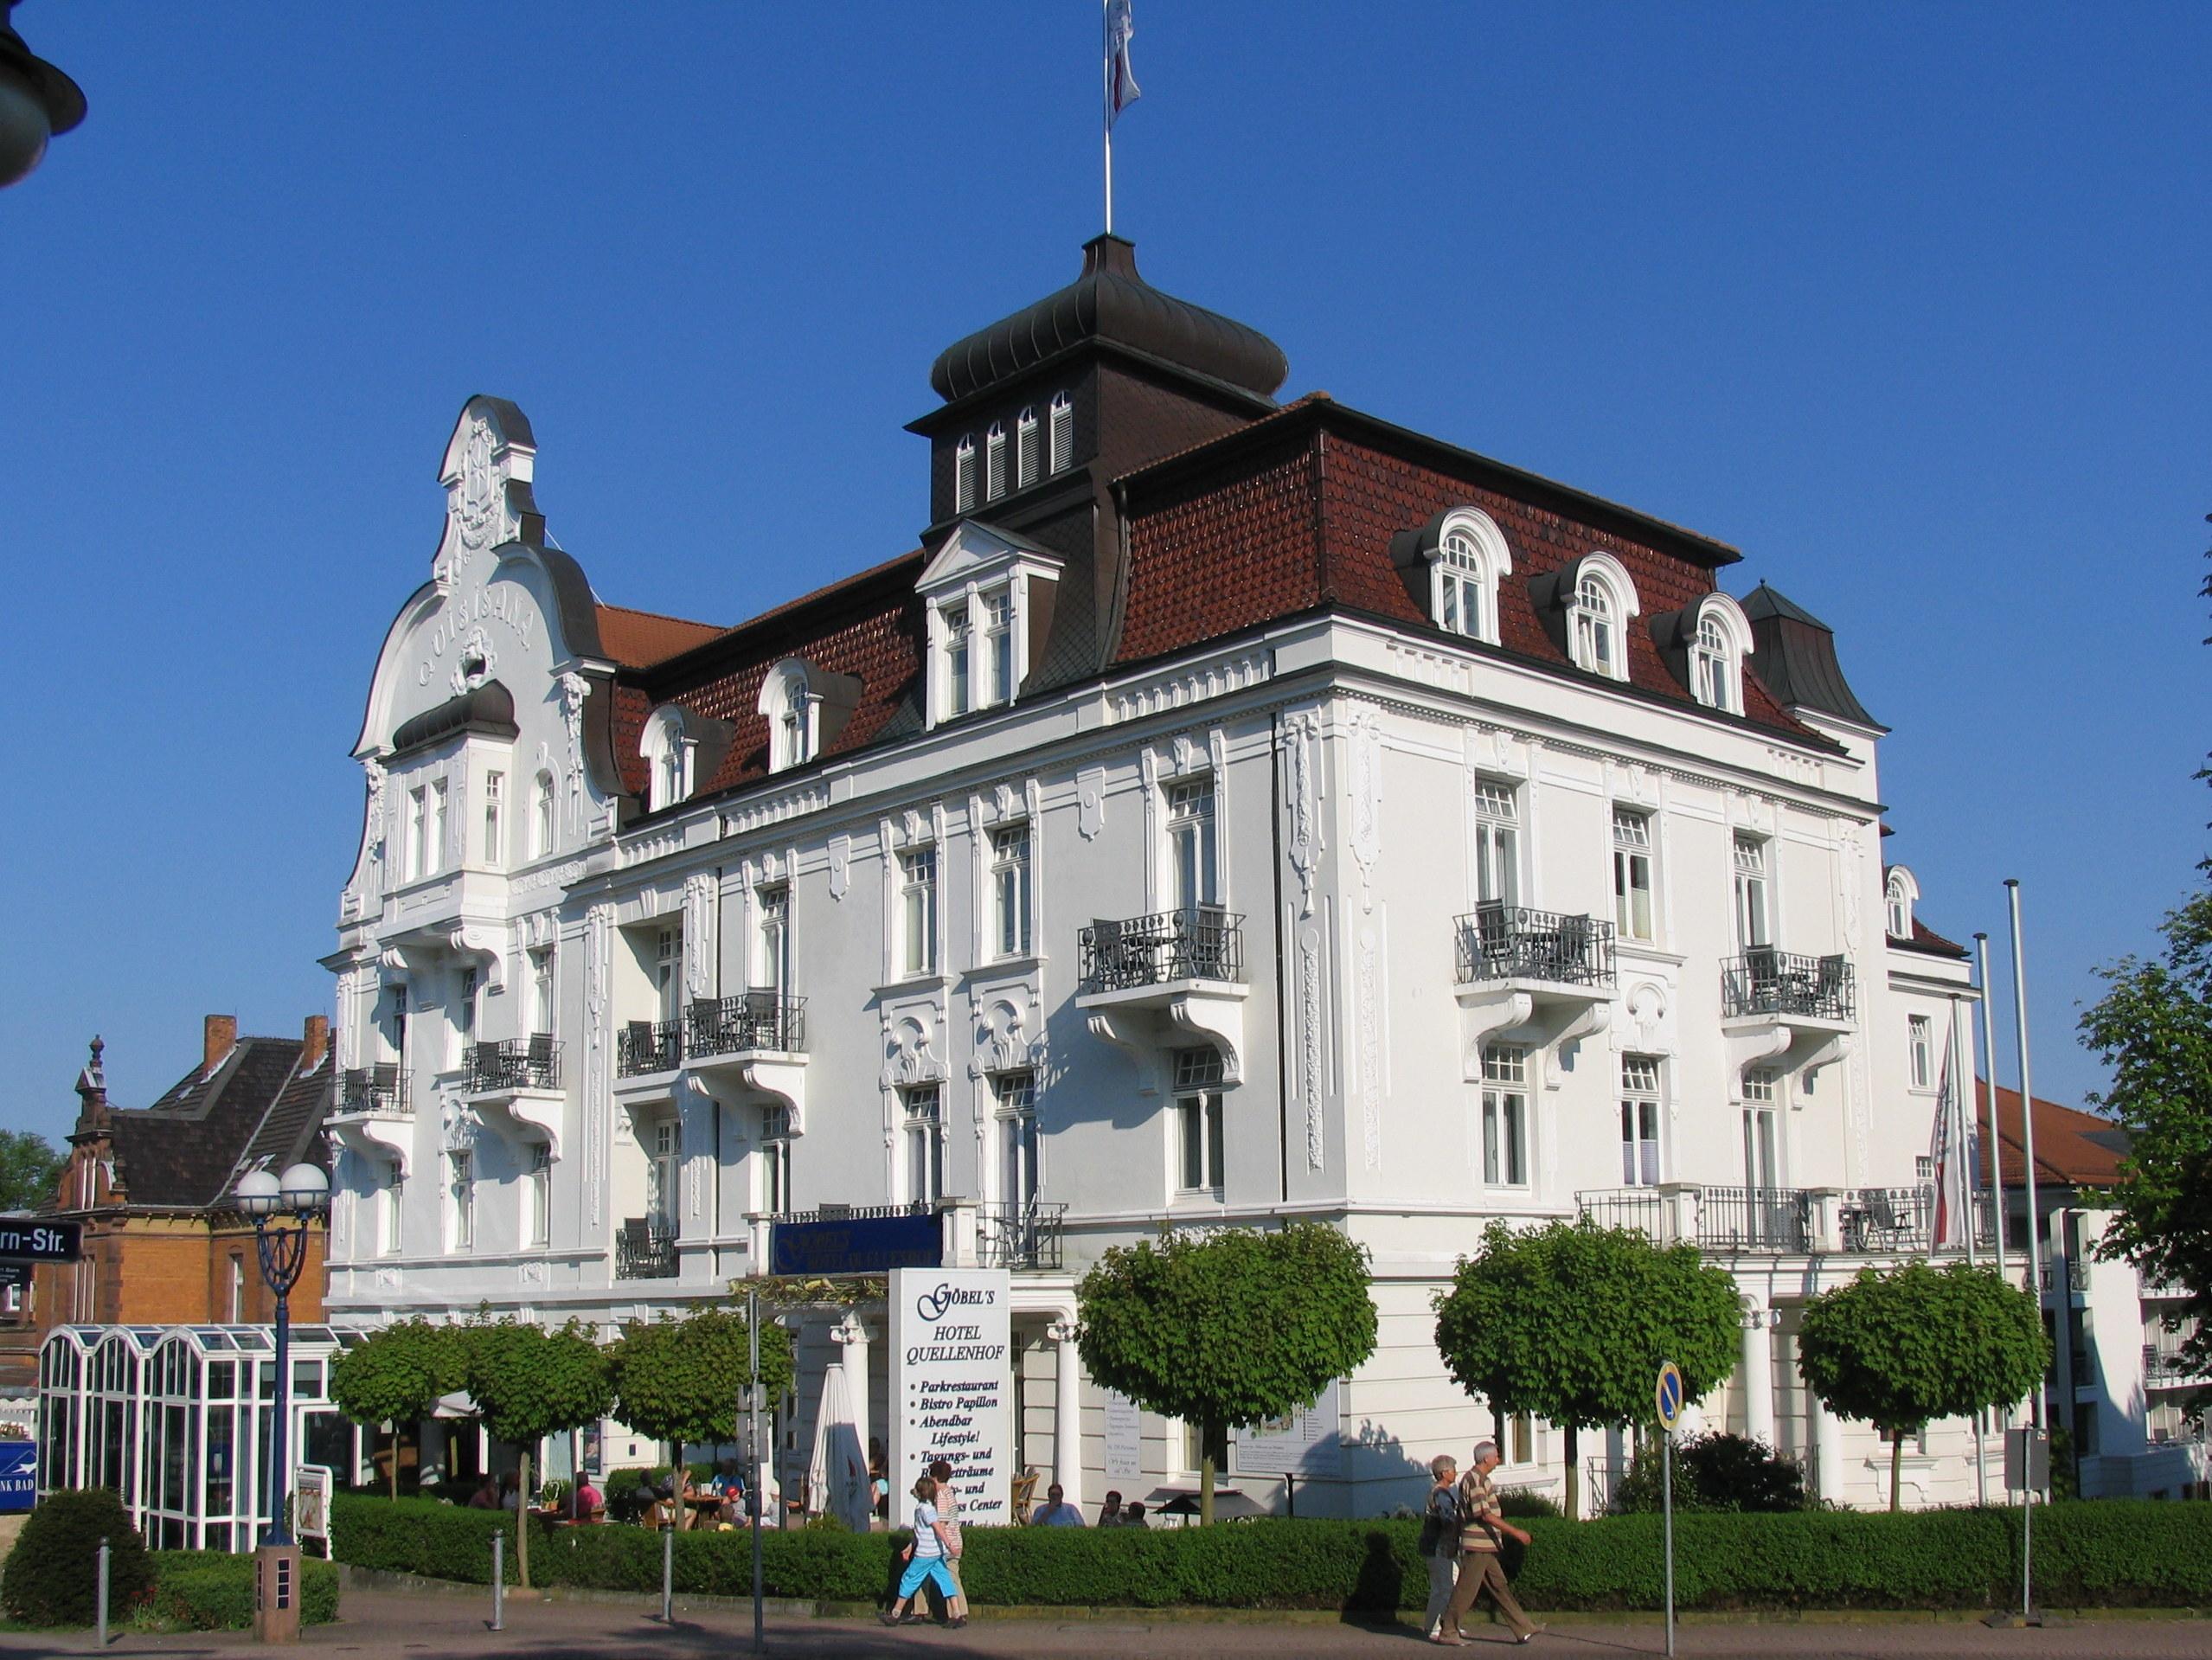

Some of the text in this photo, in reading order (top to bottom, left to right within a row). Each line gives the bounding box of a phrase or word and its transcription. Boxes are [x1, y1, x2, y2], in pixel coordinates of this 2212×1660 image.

[419, 580, 534, 687] QUISISANA
[933, 1325, 982, 1341] HOTEL
[907, 1345, 1004, 1366] QUELLENHOF
[920, 1381, 998, 1393] Parkrestaurant
[920, 1396, 997, 1412] Bistro Papillon
[919, 1414, 972, 1428] Abendbar
[931, 1431, 980, 1447] Lifestyle!
[920, 1447, 992, 1464] Tagungs- und
[16, 1478, 34, 1491] BAD
[965, 1482, 985, 1495] und
[970, 1499, 1003, 1512] Center
